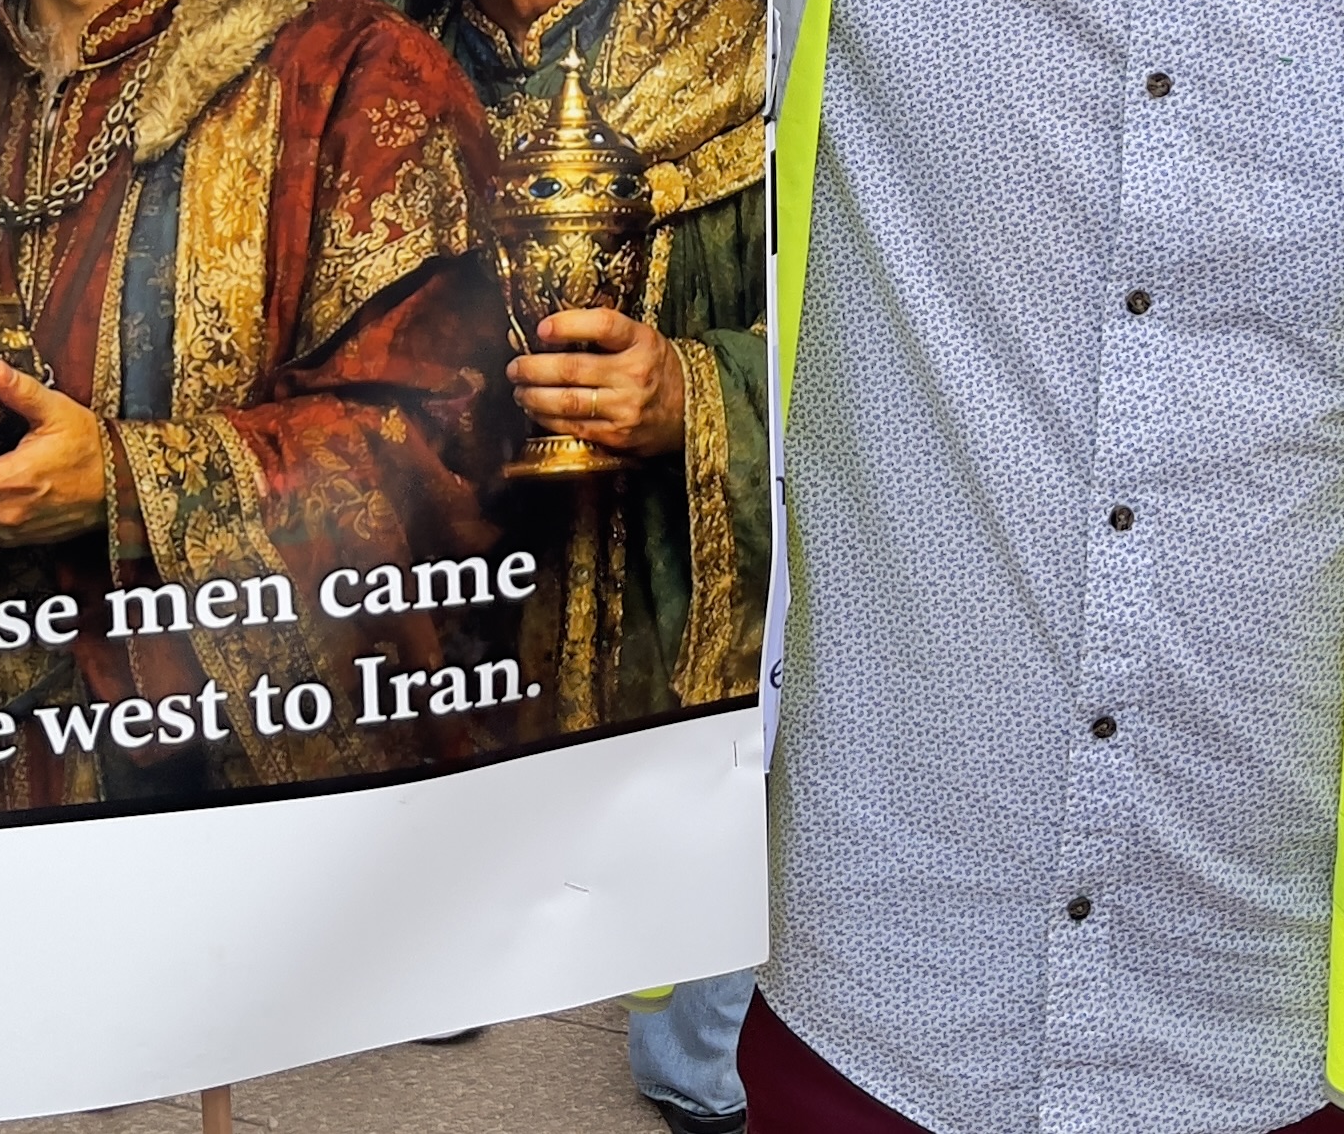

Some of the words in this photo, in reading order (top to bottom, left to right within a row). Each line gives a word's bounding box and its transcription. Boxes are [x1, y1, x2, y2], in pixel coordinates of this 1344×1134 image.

[105, 572, 298, 637] men
[319, 551, 537, 618] came
[33, 678, 231, 755] west
[249, 673, 333, 736] to
[354, 655, 542, 725] Iran.
